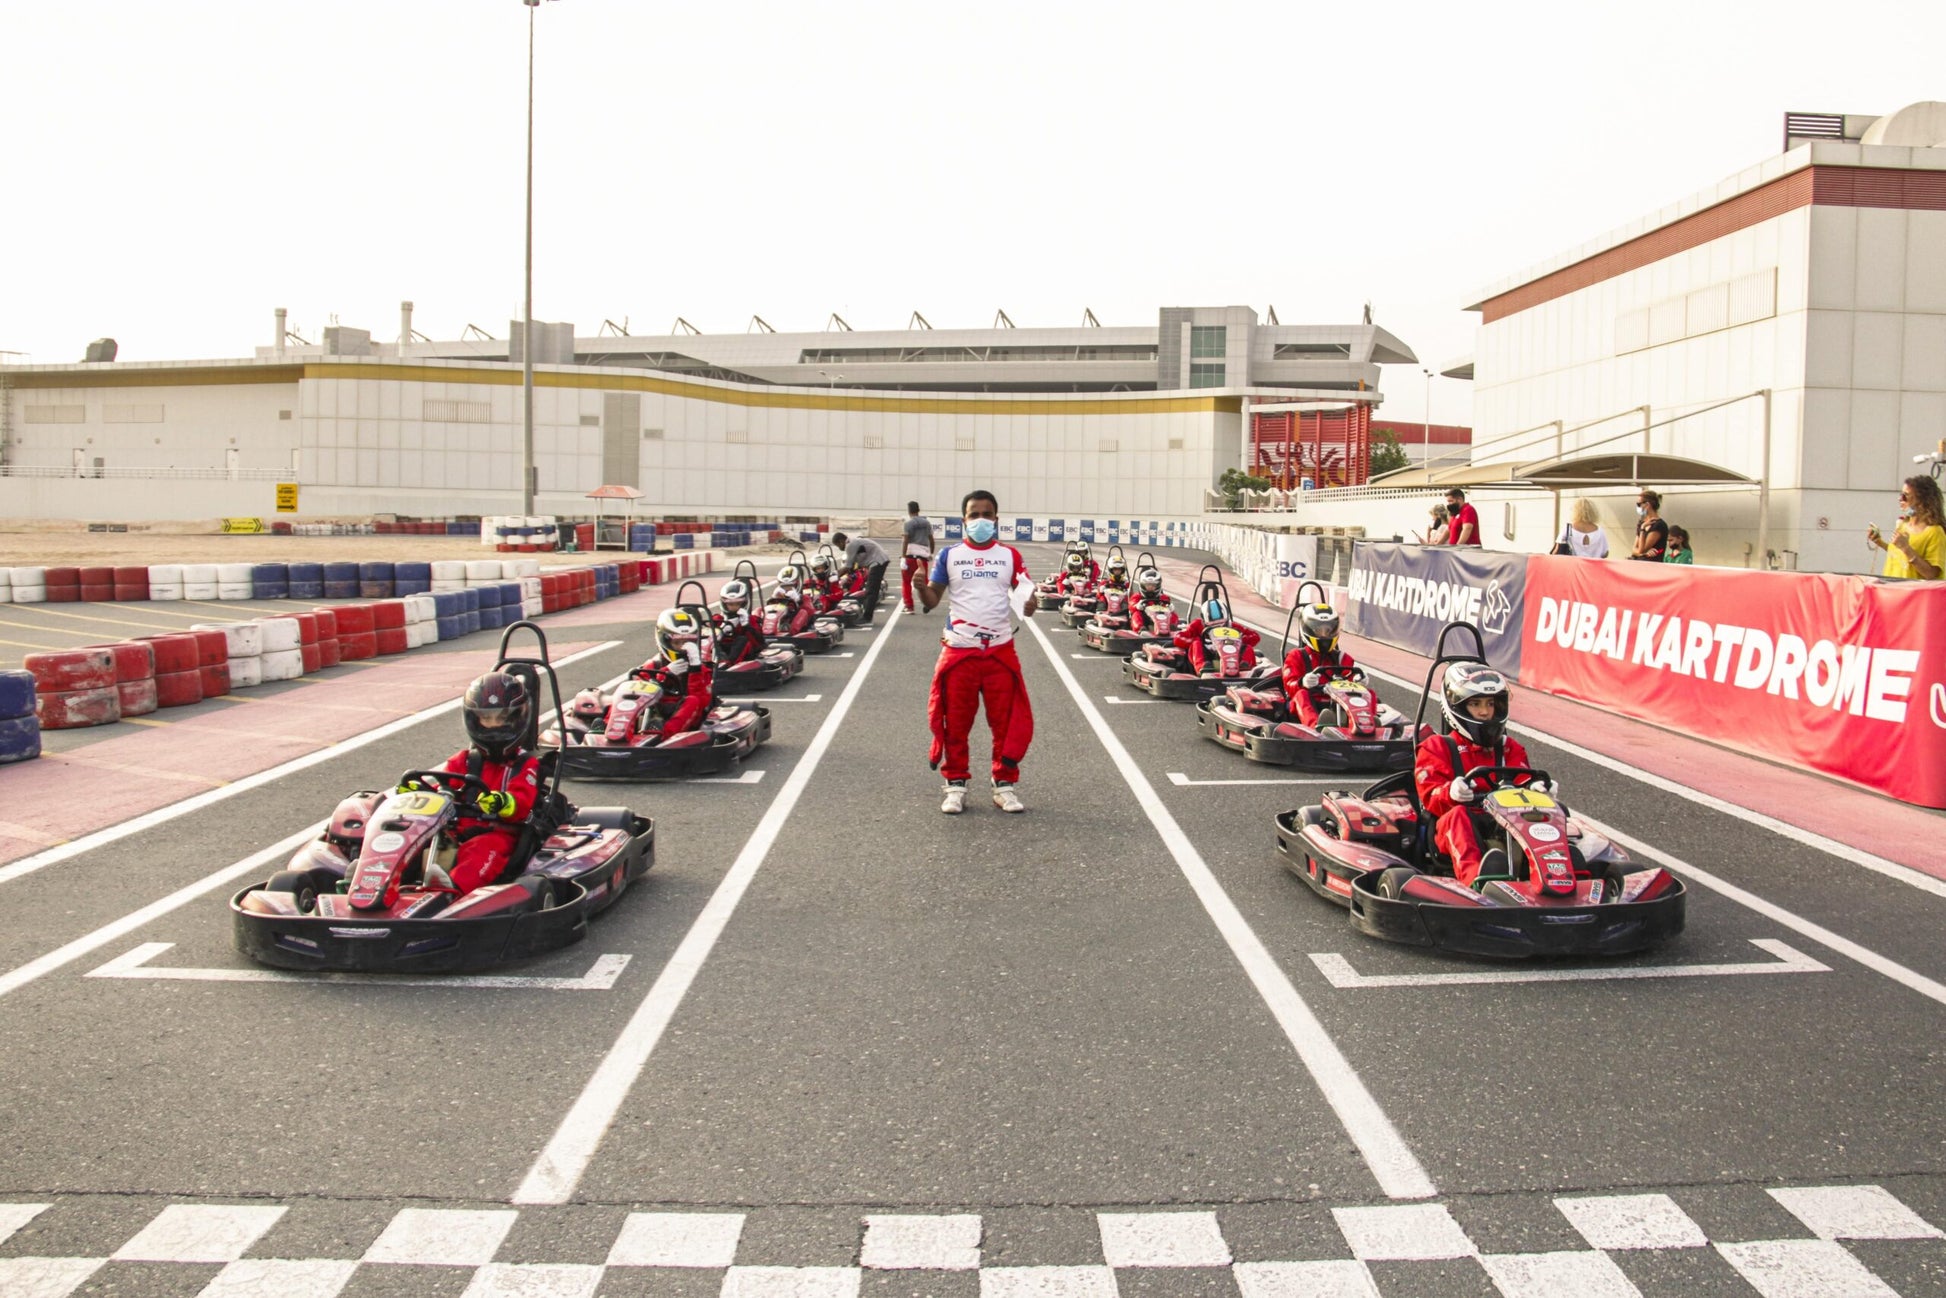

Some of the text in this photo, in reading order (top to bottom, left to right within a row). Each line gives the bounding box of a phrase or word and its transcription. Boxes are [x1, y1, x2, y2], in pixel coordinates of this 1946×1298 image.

[1373, 572, 1483, 628] KARTDROME
[1535, 596, 1921, 724] DUBAI KARTDROME
[1513, 790, 1530, 803] 1
